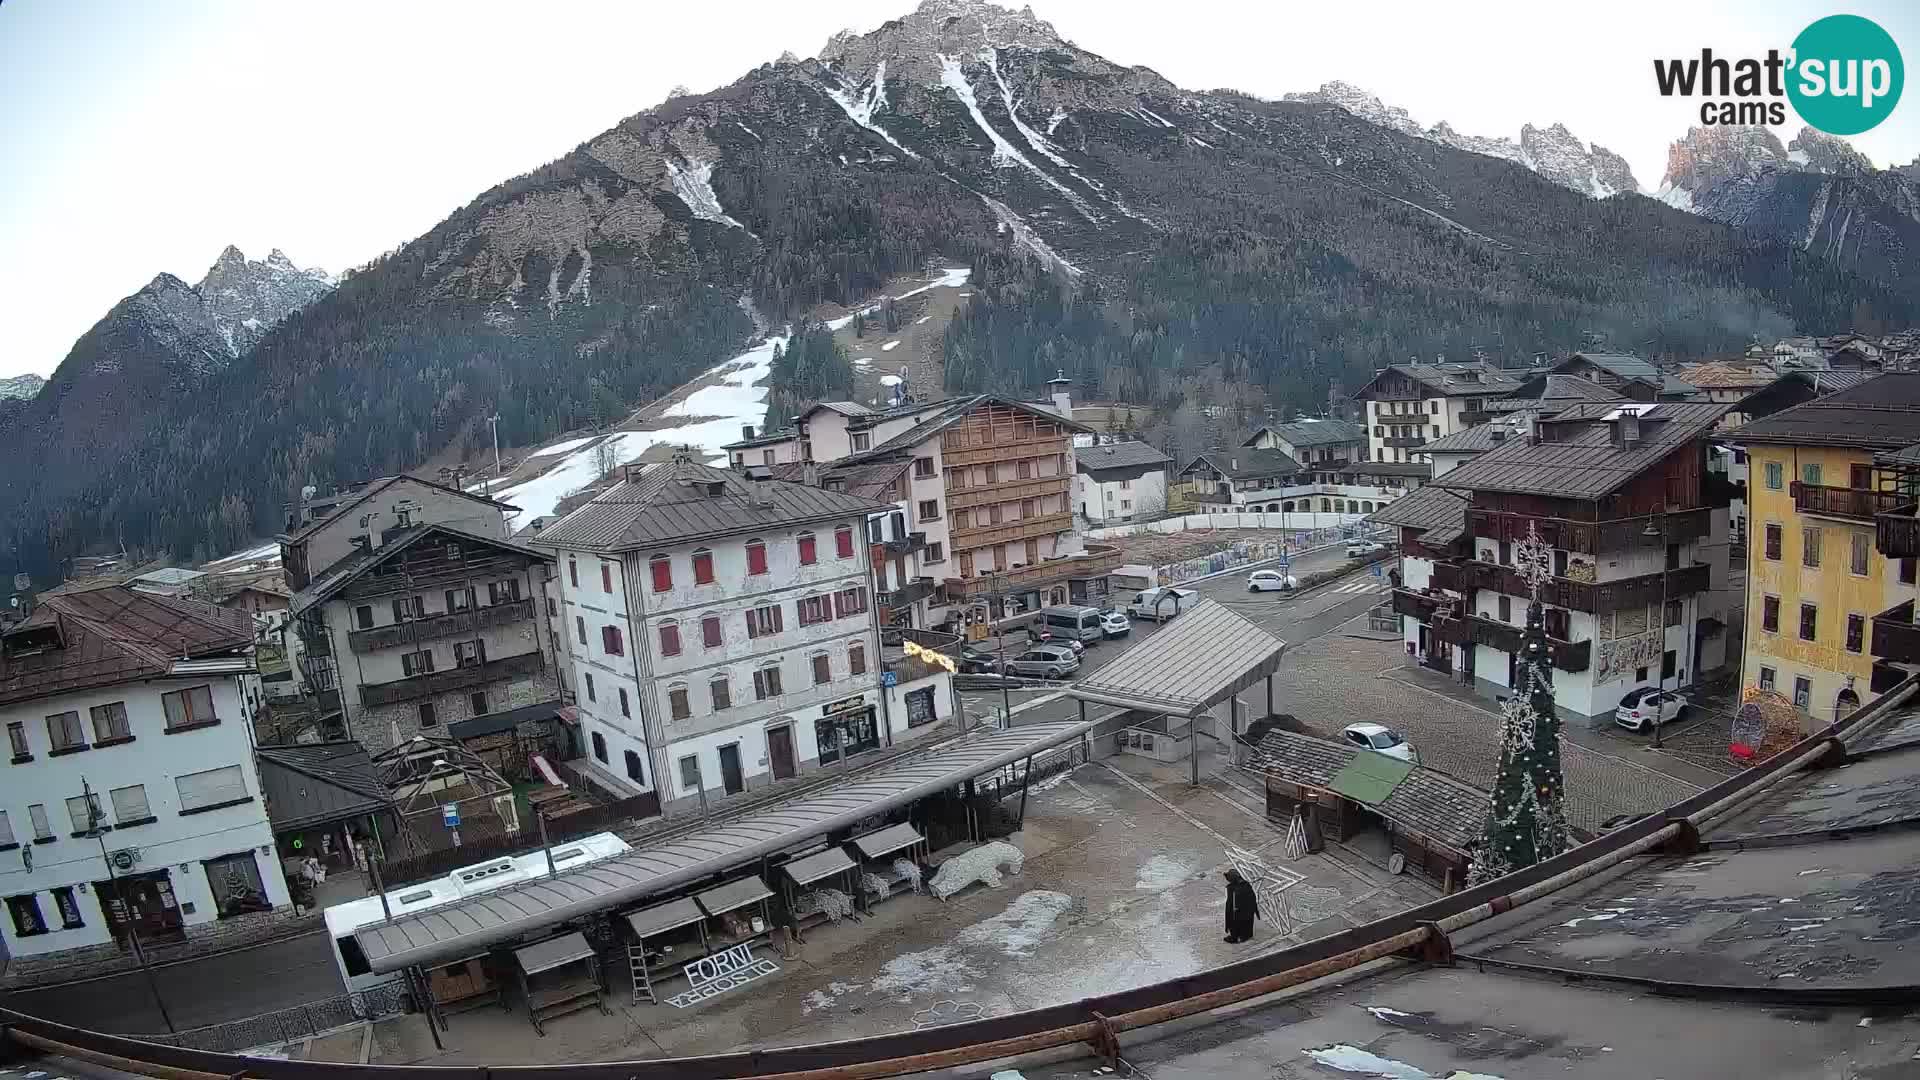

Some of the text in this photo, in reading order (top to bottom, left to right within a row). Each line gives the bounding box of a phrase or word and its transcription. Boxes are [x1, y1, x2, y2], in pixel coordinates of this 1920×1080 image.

[663, 958, 780, 1008] DI SOPRA
[684, 942, 754, 988] FORNI
